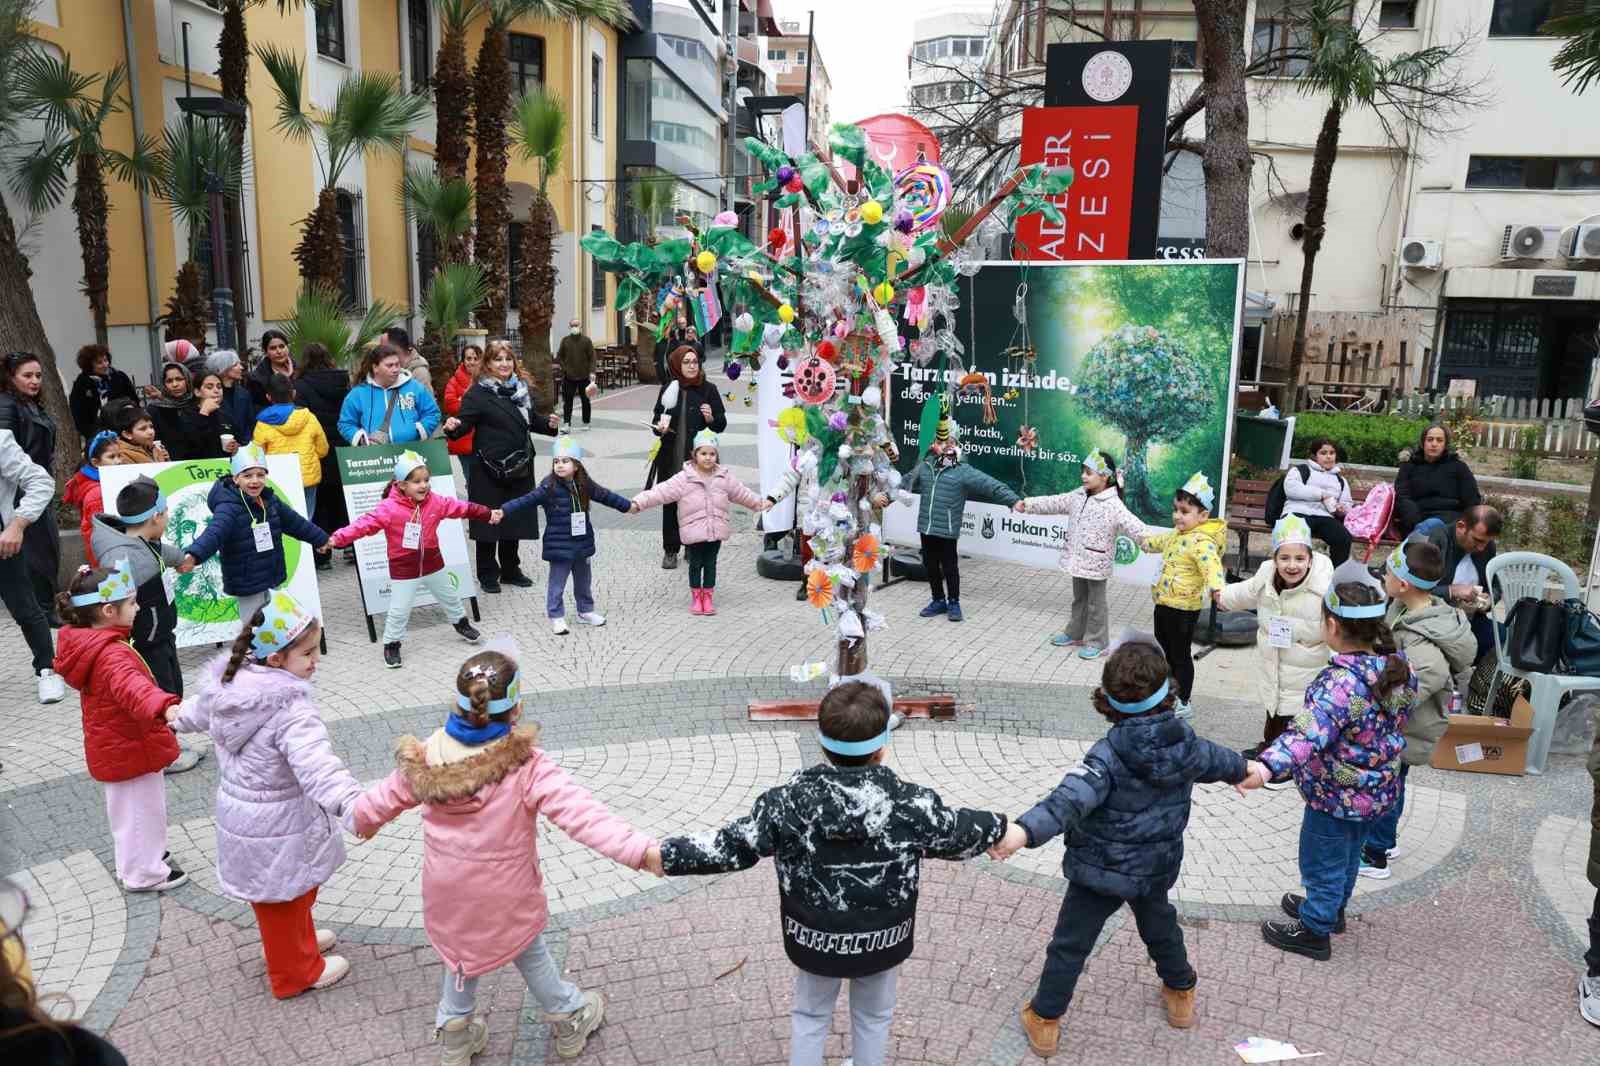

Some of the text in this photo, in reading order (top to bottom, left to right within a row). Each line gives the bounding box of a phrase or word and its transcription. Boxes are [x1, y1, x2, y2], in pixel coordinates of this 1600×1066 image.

[1002, 367, 1077, 394] izinde,
[974, 425, 1004, 440] katkı,
[1039, 448, 1056, 460] bir
[1057, 451, 1081, 463] söz.
[1001, 517, 1048, 537] Hakan
[785, 916, 912, 954] PERFECTION
